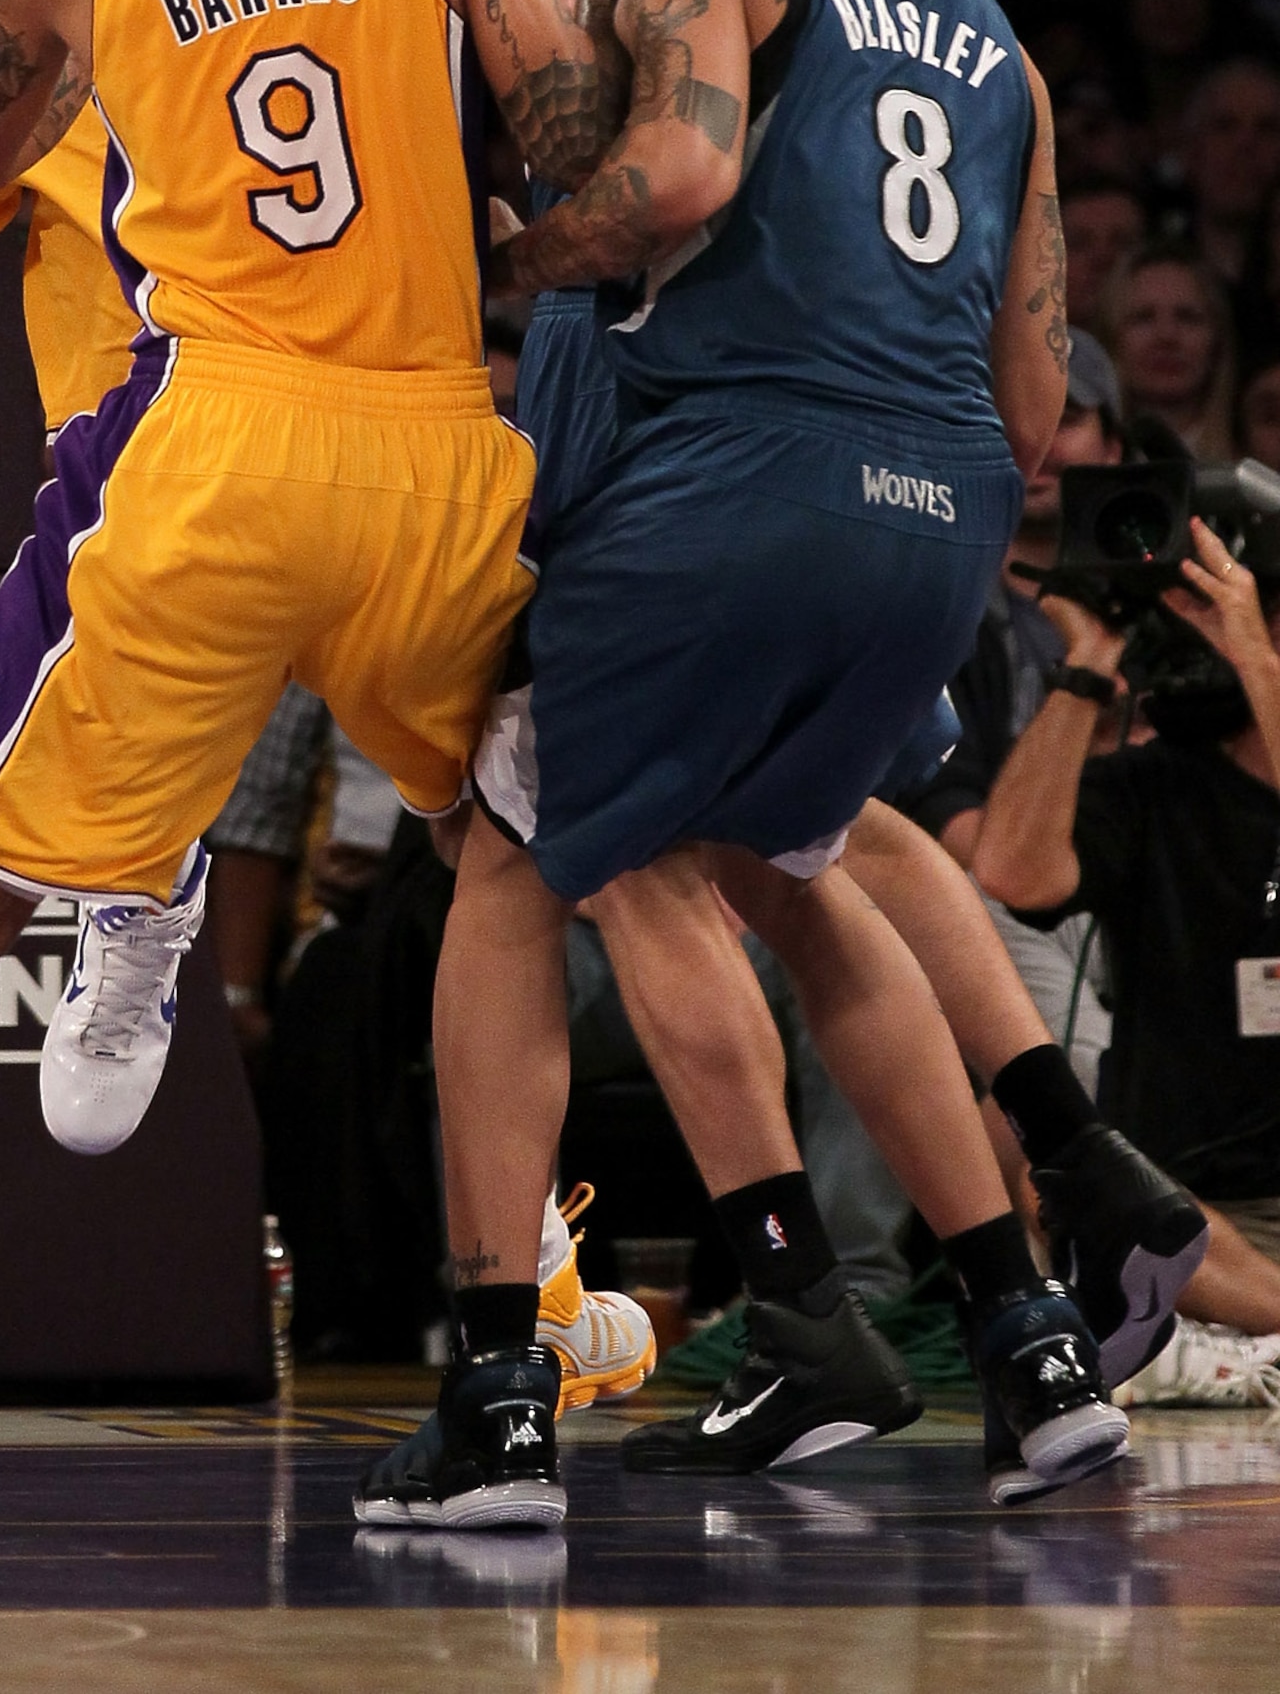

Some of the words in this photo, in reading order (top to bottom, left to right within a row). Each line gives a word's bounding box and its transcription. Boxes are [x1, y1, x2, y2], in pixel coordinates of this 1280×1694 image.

[226, 44, 363, 254] 9
[875, 87, 962, 265] 8
[861, 464, 957, 524] WOLVES
